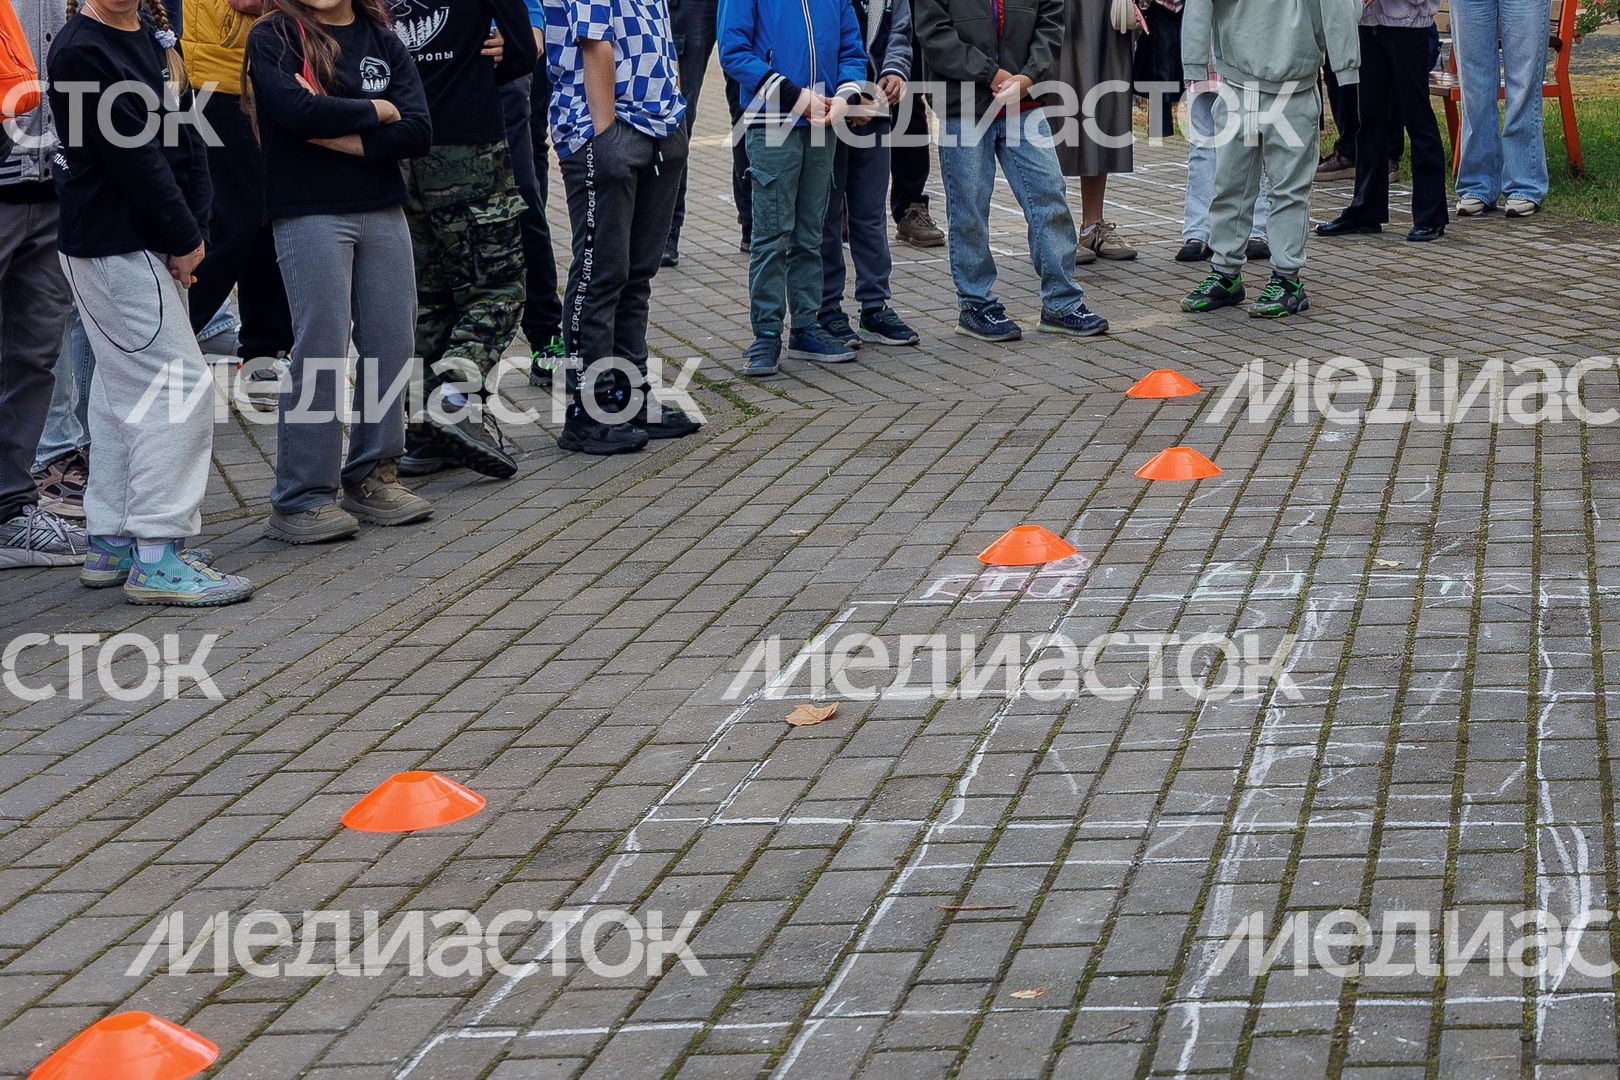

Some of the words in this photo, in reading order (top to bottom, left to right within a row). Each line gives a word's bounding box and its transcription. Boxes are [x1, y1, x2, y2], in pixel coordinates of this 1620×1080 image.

[582, 247, 594, 281] SCHOOL
[577, 282, 588, 292] IN
[571, 294, 586, 332] EXPLORE
